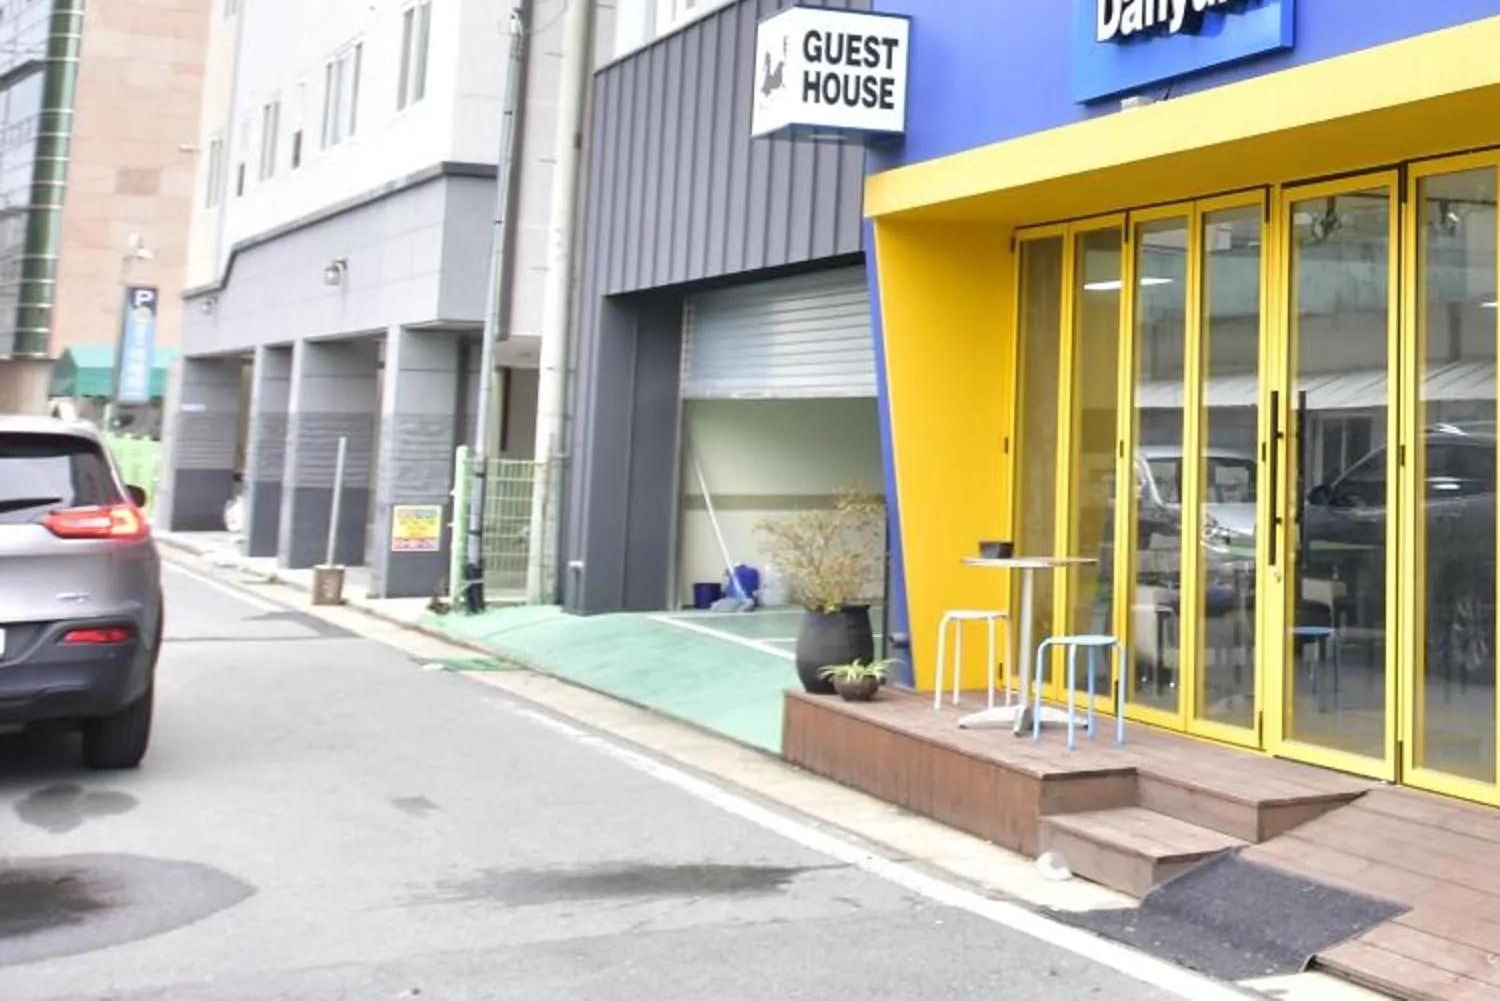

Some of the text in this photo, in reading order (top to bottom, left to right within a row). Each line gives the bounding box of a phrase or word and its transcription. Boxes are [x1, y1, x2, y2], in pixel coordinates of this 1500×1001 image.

[803, 29, 899, 70] GUEST
[802, 70, 895, 110] HOUSE
[134, 290, 154, 307] P
